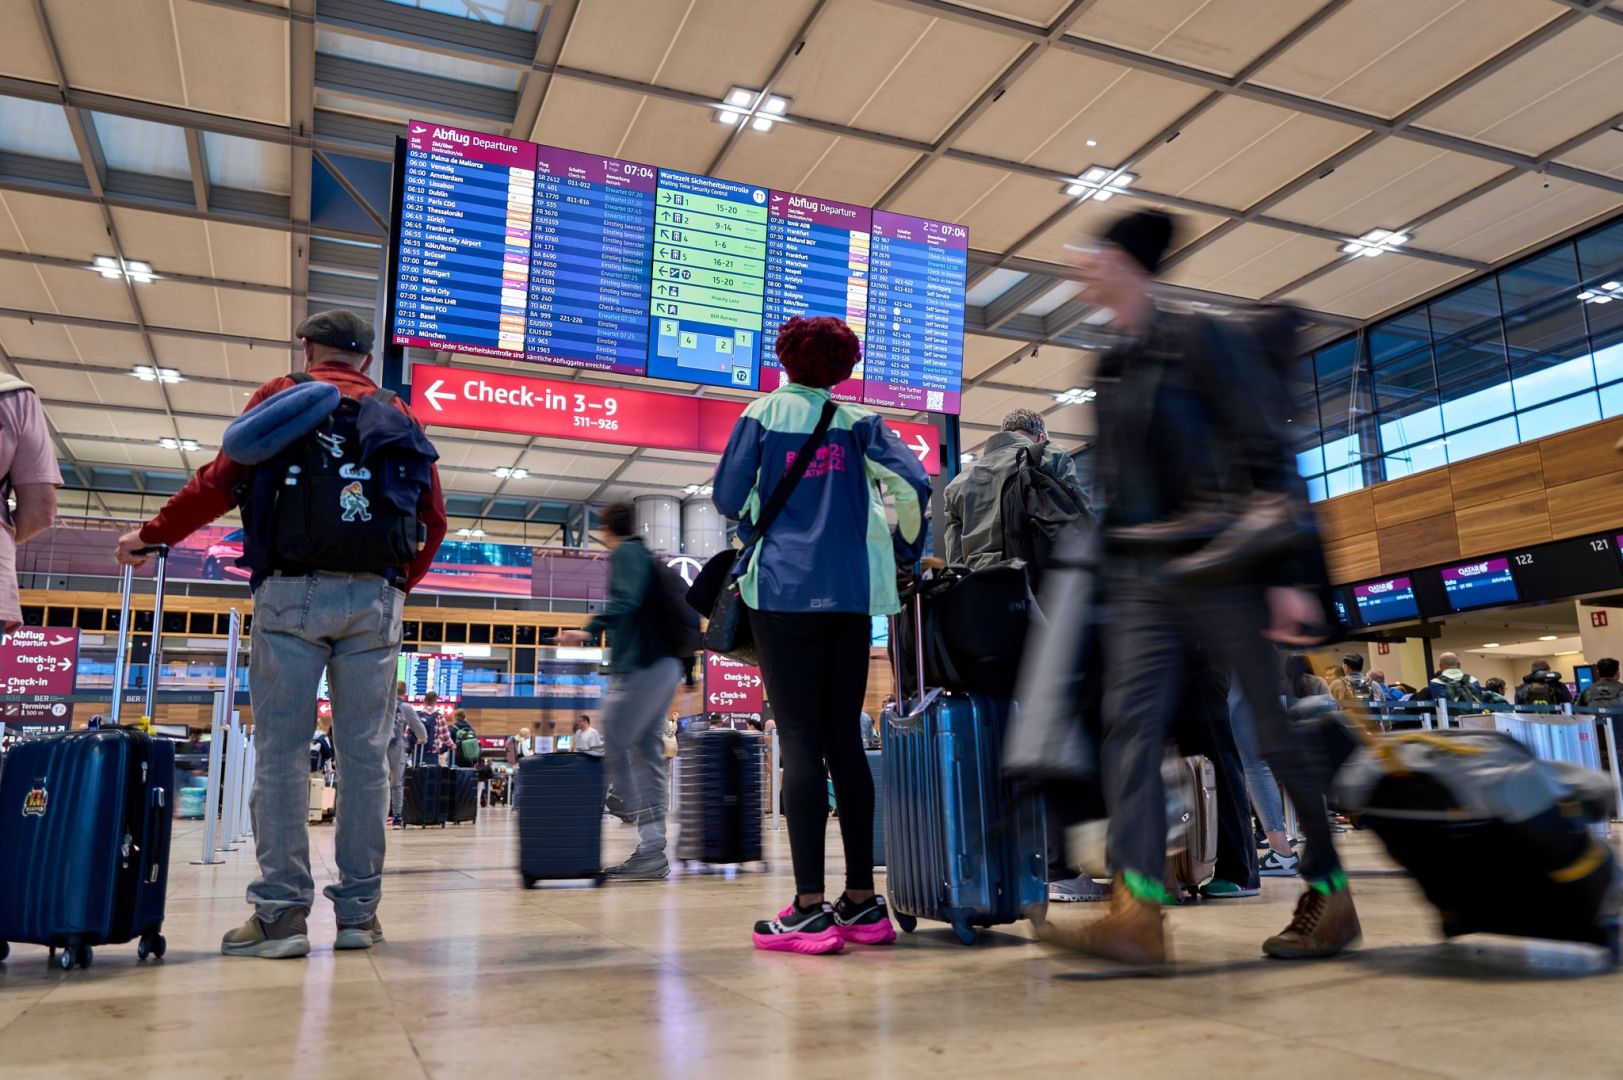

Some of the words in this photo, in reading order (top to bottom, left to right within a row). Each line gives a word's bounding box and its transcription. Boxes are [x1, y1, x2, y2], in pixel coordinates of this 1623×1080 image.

[433, 127, 470, 147] Abflug
[473, 137, 518, 155] Departure
[410, 150, 427, 158] 05:20
[431, 154, 449, 162] Palma
[459, 159, 483, 169] Mallorca
[410, 159, 427, 167] 06:00
[431, 163, 454, 174] Venedig
[624, 165, 653, 179] 07:04
[409, 168, 426, 176] 06:00
[430, 171, 463, 182] Amsterdam
[408, 176, 426, 184] 06:00
[430, 180, 454, 190] Lissabon
[568, 179, 590, 188] 011-012
[660, 179, 678, 188] Waiting
[692, 185, 712, 194] Security
[661, 171, 690, 183] Wartezeit
[691, 177, 749, 195] Sicherheitskontrolle
[408, 185, 425, 193] 06:10
[429, 189, 448, 197] Dublin
[407, 194, 424, 202] 06:15
[406, 203, 424, 211] 06:25
[428, 206, 463, 217] Thessaloniki
[716, 204, 737, 215] 15-20
[788, 197, 817, 212] Abflug
[820, 204, 856, 217] Departure
[406, 211, 423, 219] 06:45
[427, 215, 445, 223] Zürich
[405, 220, 422, 228] 06:45
[426, 224, 454, 233] Frankfurt
[604, 220, 624, 230] Einstieg
[624, 223, 645, 232] beendet
[716, 222, 732, 232] 9-14
[924, 222, 928, 230] 2
[941, 226, 965, 238] 07:04
[787, 228, 809, 236] Frankfurt
[404, 229, 422, 237] 06:55
[426, 232, 447, 241] London
[449, 236, 460, 245] City
[461, 238, 481, 248] Airport
[425, 241, 456, 251] Köln/Bonn
[715, 240, 727, 249] 1-6
[424, 250, 446, 259] Brüssel
[714, 258, 734, 268] 16-21
[423, 268, 450, 279] Stuttgart
[713, 276, 734, 287] 15-20
[438, 288, 450, 297] Orly
[421, 294, 443, 303] London
[599, 295, 619, 304] Einstieg
[560, 315, 583, 323] 221-226
[598, 320, 618, 329] Einstieg
[419, 330, 446, 339] München
[442, 343, 457, 351] jeder
[458, 345, 511, 357] Sicherheitskontrolle
[552, 358, 584, 368] Abfluggates
[463, 380, 566, 411] Check-in
[1590, 539, 1609, 552] 121
[1515, 554, 1534, 565] 122
[1458, 566, 1479, 576] QATAR
[14, 631, 45, 640] Abflug
[17, 656, 56, 664] Check-in
[8, 678, 48, 686] Check-in
